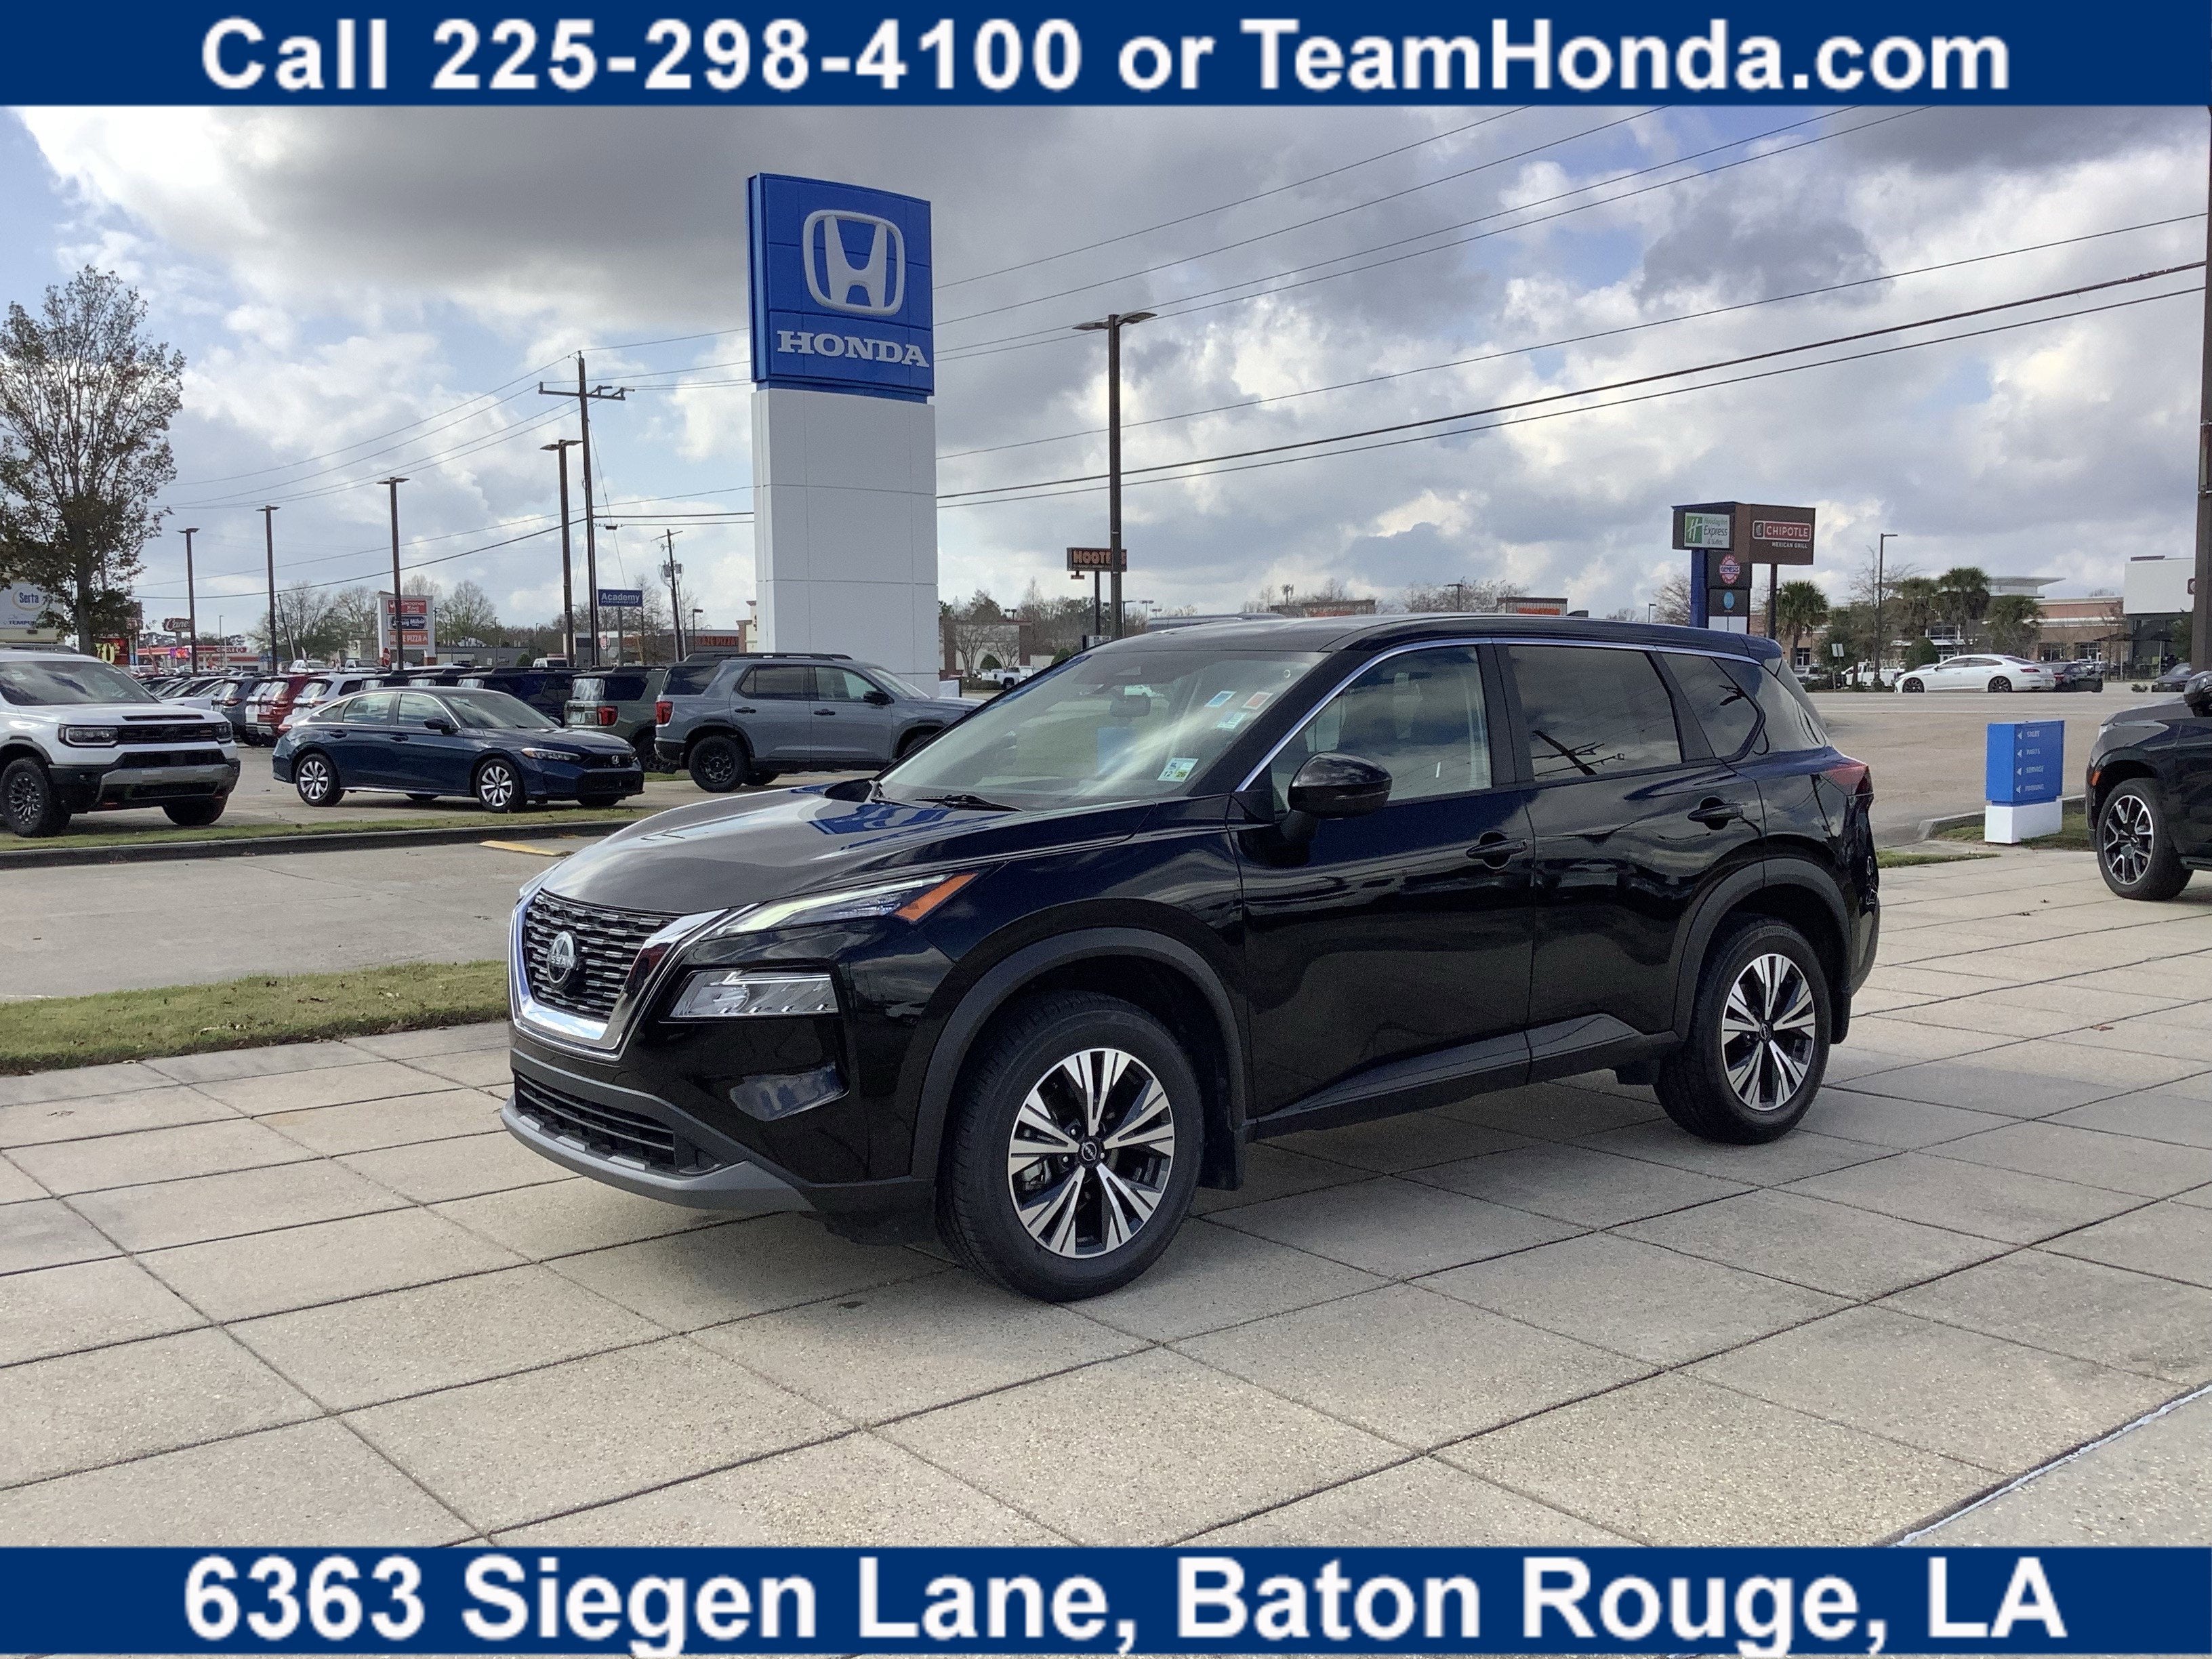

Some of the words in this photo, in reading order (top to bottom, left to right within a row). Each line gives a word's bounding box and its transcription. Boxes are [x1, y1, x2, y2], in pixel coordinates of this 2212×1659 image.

[777, 330, 930, 368] HONDA
[1704, 525, 1727, 537] Express
[1766, 525, 1809, 537] CHIPOTLE
[1073, 550, 1126, 565] HOOTES
[19, 592, 39, 603] Serta
[601, 592, 640, 603] Academy
[165, 618, 190, 630] Cane
